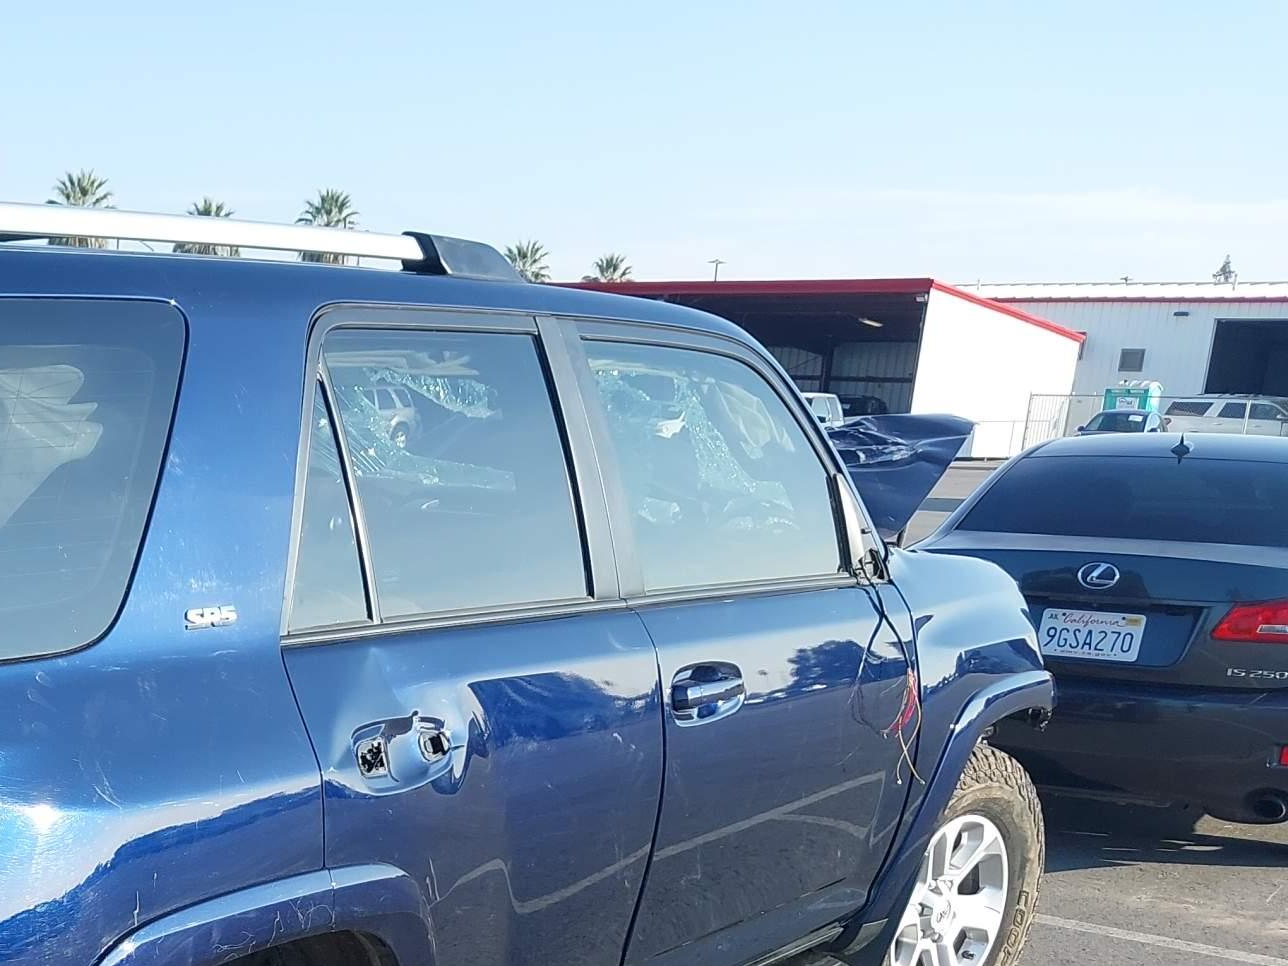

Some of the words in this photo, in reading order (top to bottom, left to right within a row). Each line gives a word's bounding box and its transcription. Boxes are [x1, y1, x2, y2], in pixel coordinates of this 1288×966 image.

[184, 605, 237, 630] SR5
[1063, 613, 1127, 628] California
[1043, 626, 1134, 653] 9GSA270
